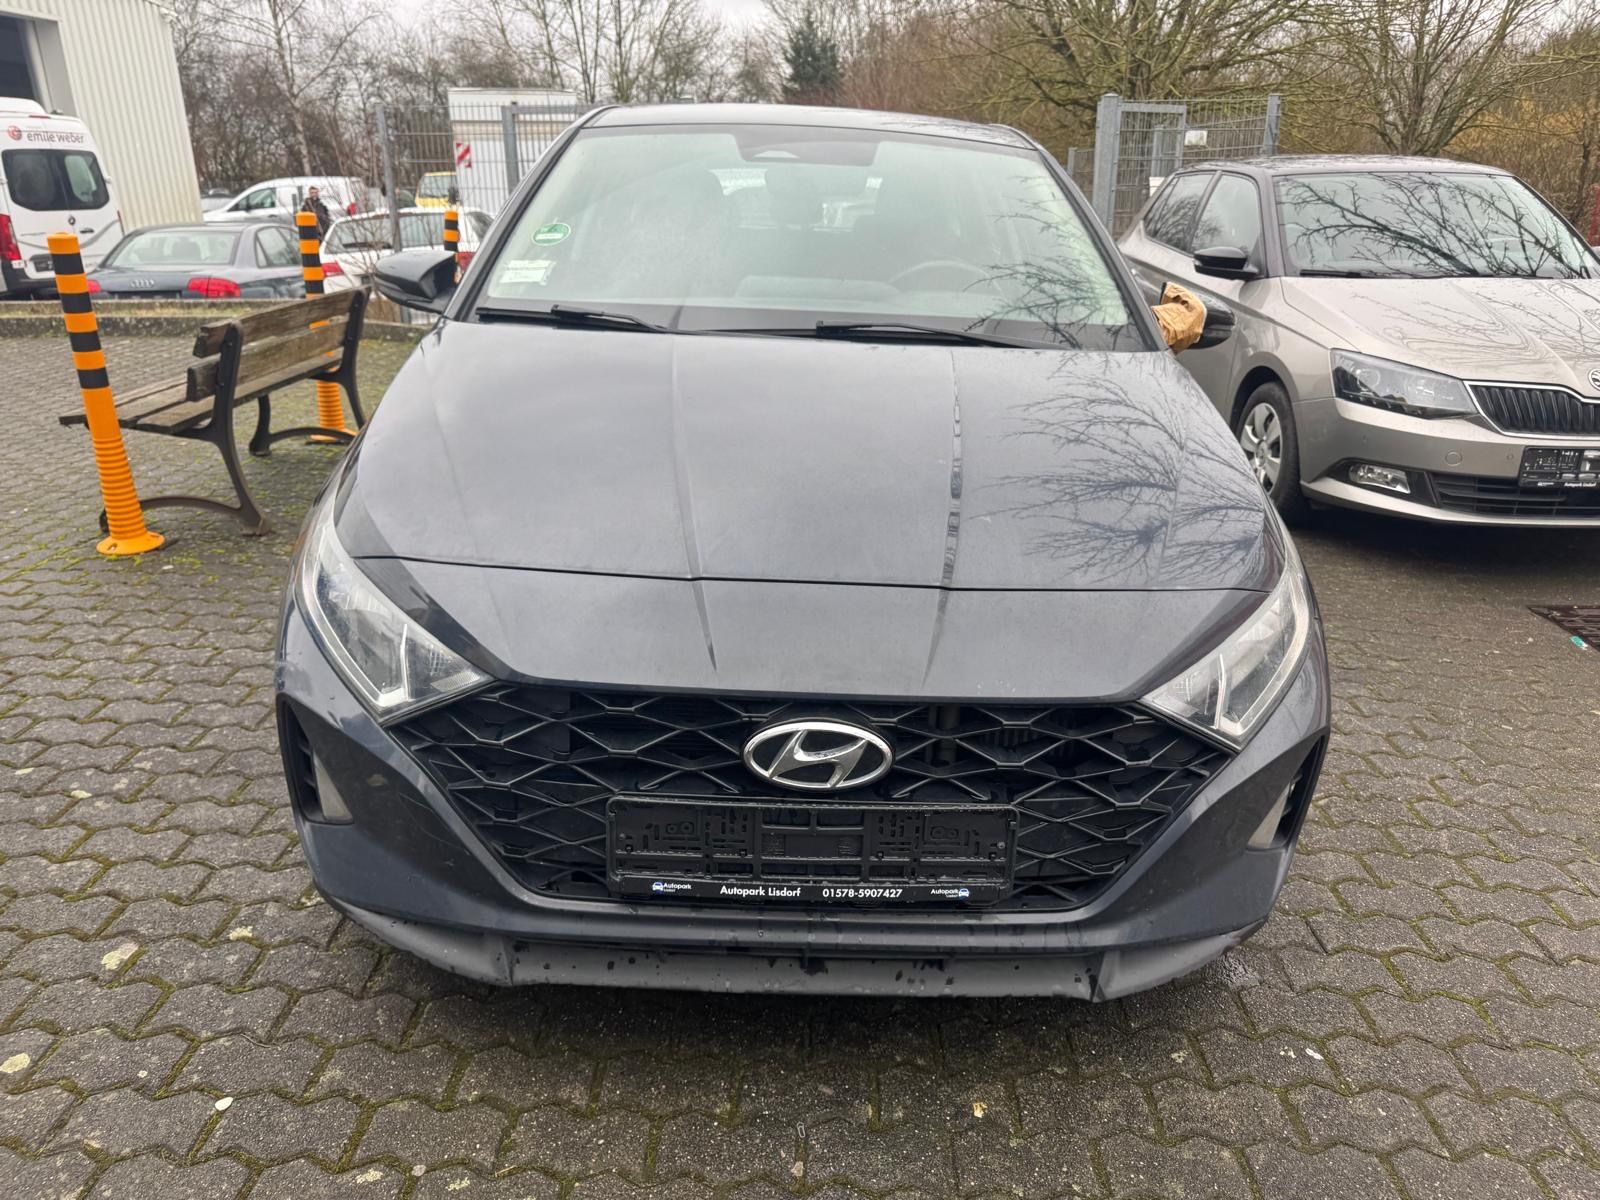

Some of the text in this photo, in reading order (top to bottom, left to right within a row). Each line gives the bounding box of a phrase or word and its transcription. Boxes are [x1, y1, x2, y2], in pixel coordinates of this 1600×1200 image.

[27, 131, 84, 143] emile weber
[663, 882, 692, 890] Autopark
[720, 885, 903, 898] Autopark Lisdorf 01578-5907427
